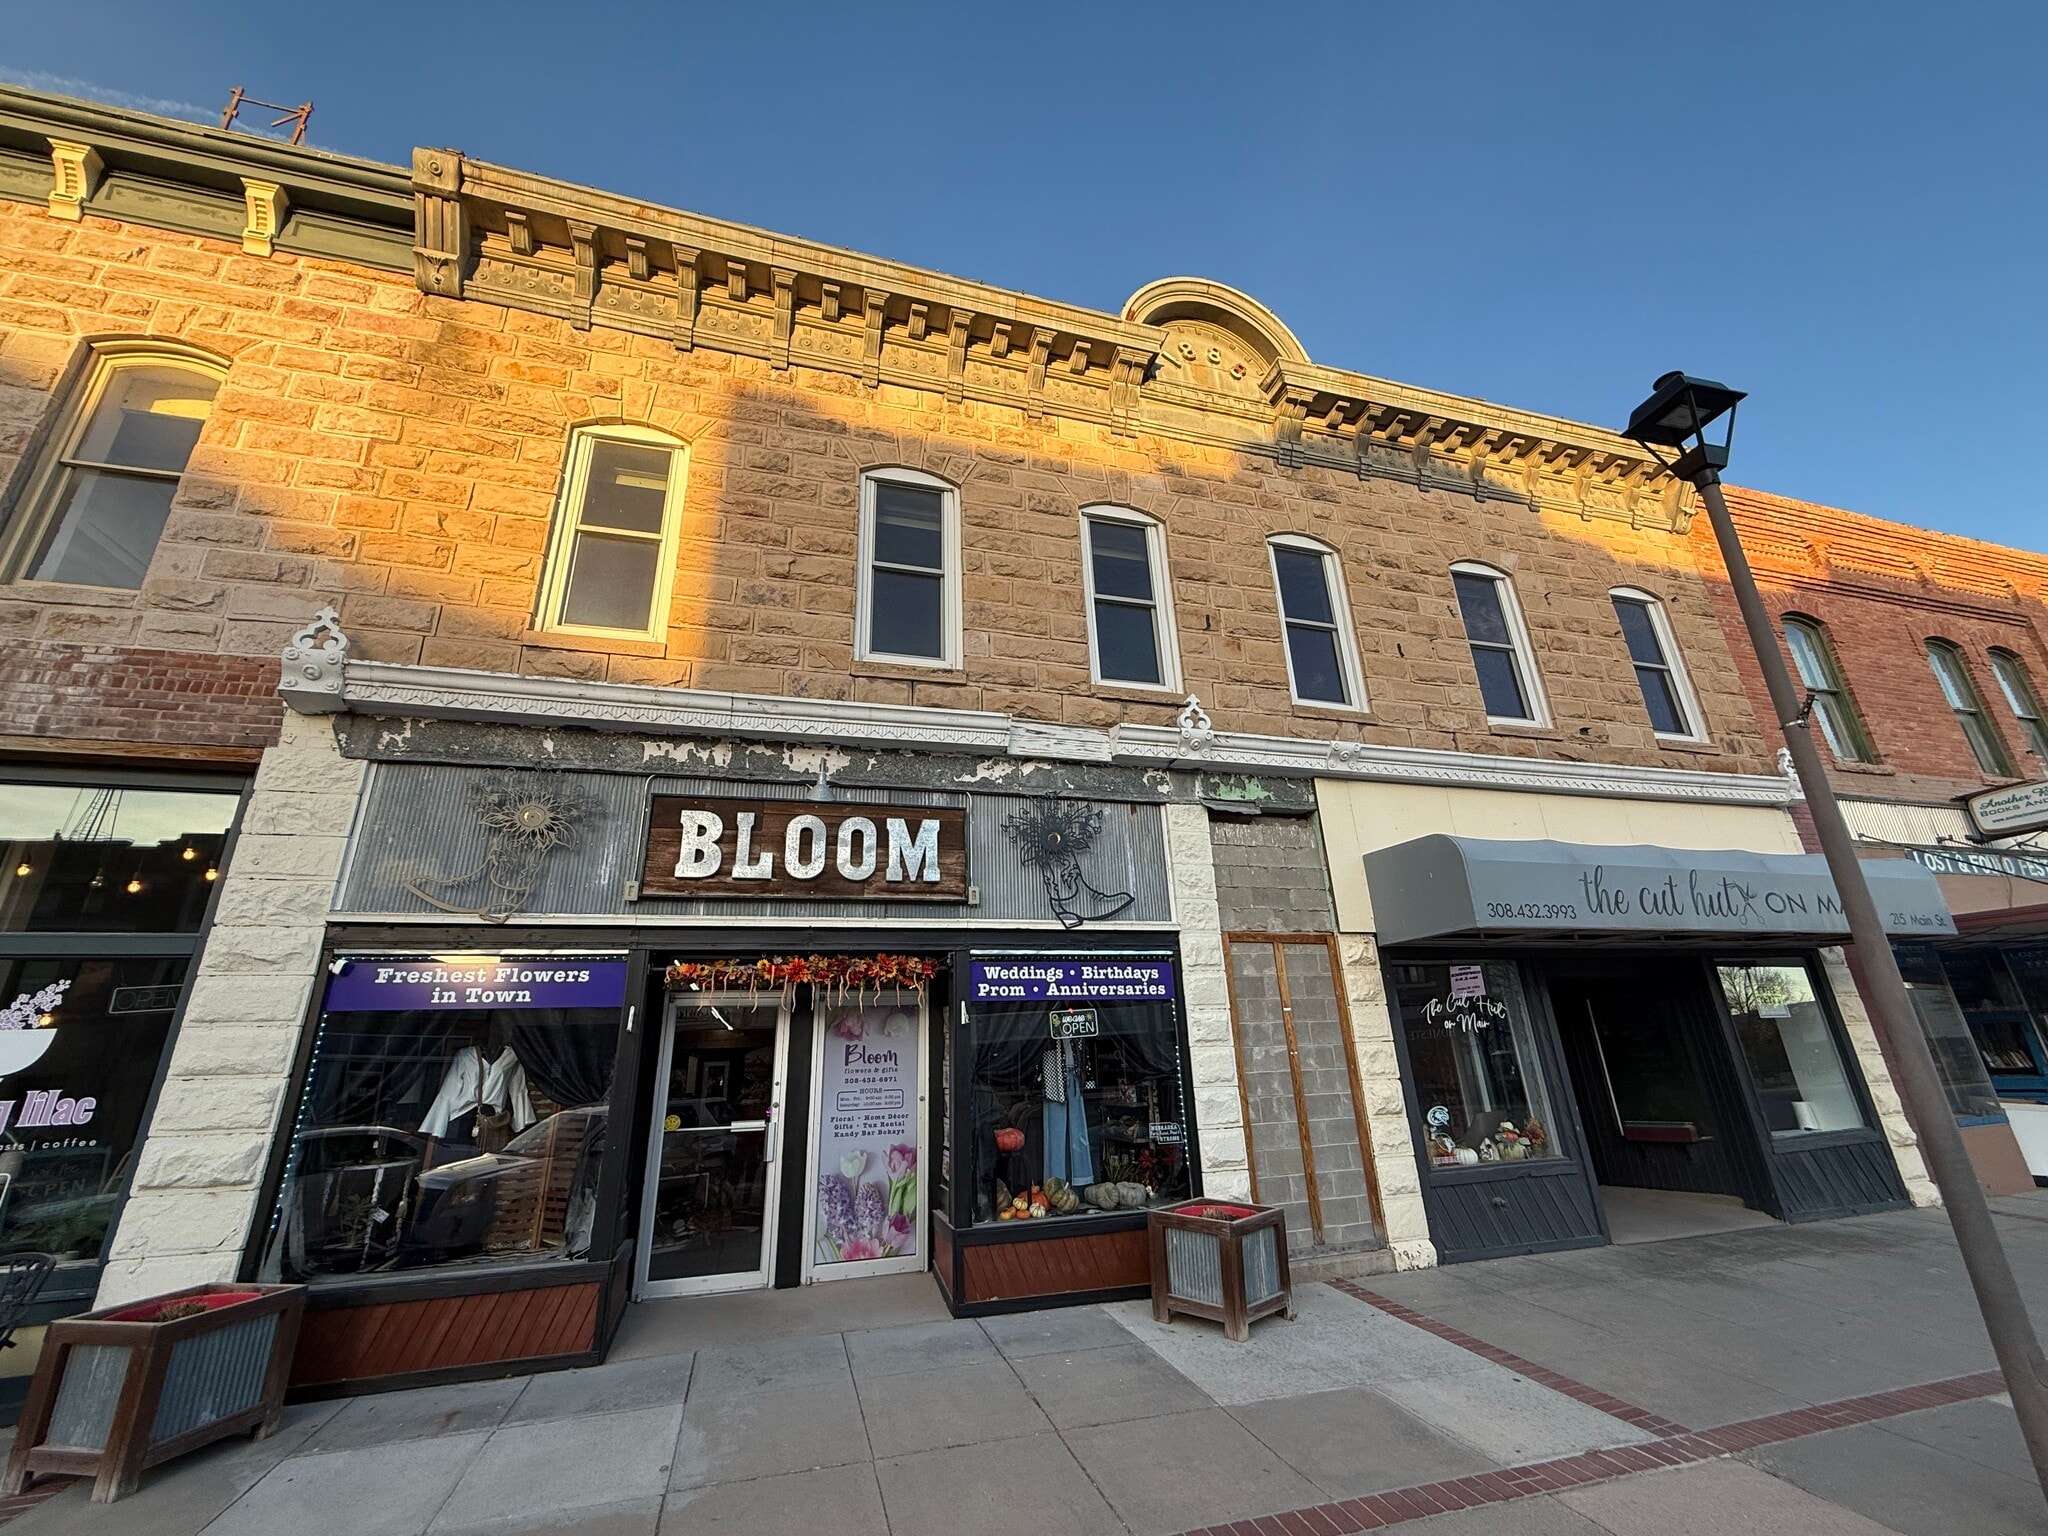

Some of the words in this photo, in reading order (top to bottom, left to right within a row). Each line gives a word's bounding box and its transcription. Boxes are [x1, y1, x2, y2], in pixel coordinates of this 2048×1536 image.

[1979, 793, 2031, 810] Another
[674, 809, 941, 882] BLOOM
[1912, 850, 1953, 873] LOST
[1579, 865, 1630, 915] the
[1639, 875, 1684, 917] cut
[1689, 869, 1738, 918] hut
[1764, 891, 1808, 915] ON
[1487, 902, 1577, 920] 308.432.3993
[1890, 912, 1907, 925] 215
[1909, 911, 1934, 926] Main
[375, 967, 487, 984] Freshest
[493, 966, 591, 983] Flowers
[984, 966, 1064, 982] Weddings
[1081, 965, 1159, 982] Birthdays
[430, 986, 457, 1003] in
[465, 986, 532, 1003] Town
[977, 983, 1026, 997] Prom
[1046, 982, 1166, 997] Anniversaries
[1421, 998, 1443, 1024] The
[1446, 990, 1470, 1013] Cut
[1473, 994, 1508, 1019] Hut
[1062, 1021, 1095, 1035] OPEN
[1444, 1019, 1456, 1029] on
[1456, 1012, 1490, 1034] Main
[844, 1043, 899, 1067] Bloom
[844, 1067, 872, 1075] flowers
[881, 1066, 899, 1074] gifts
[844, 1076, 898, 1084] 308-432-6971
[859, 1087, 883, 1095] HOURS
[14, 1089, 97, 1128] lilac
[830, 1115, 855, 1123] Floral
[833, 1123, 853, 1131] Gifts
[880, 1120, 905, 1128] Rental
[833, 1130, 859, 1138] Kandy
[41, 1137, 98, 1149] coffee
